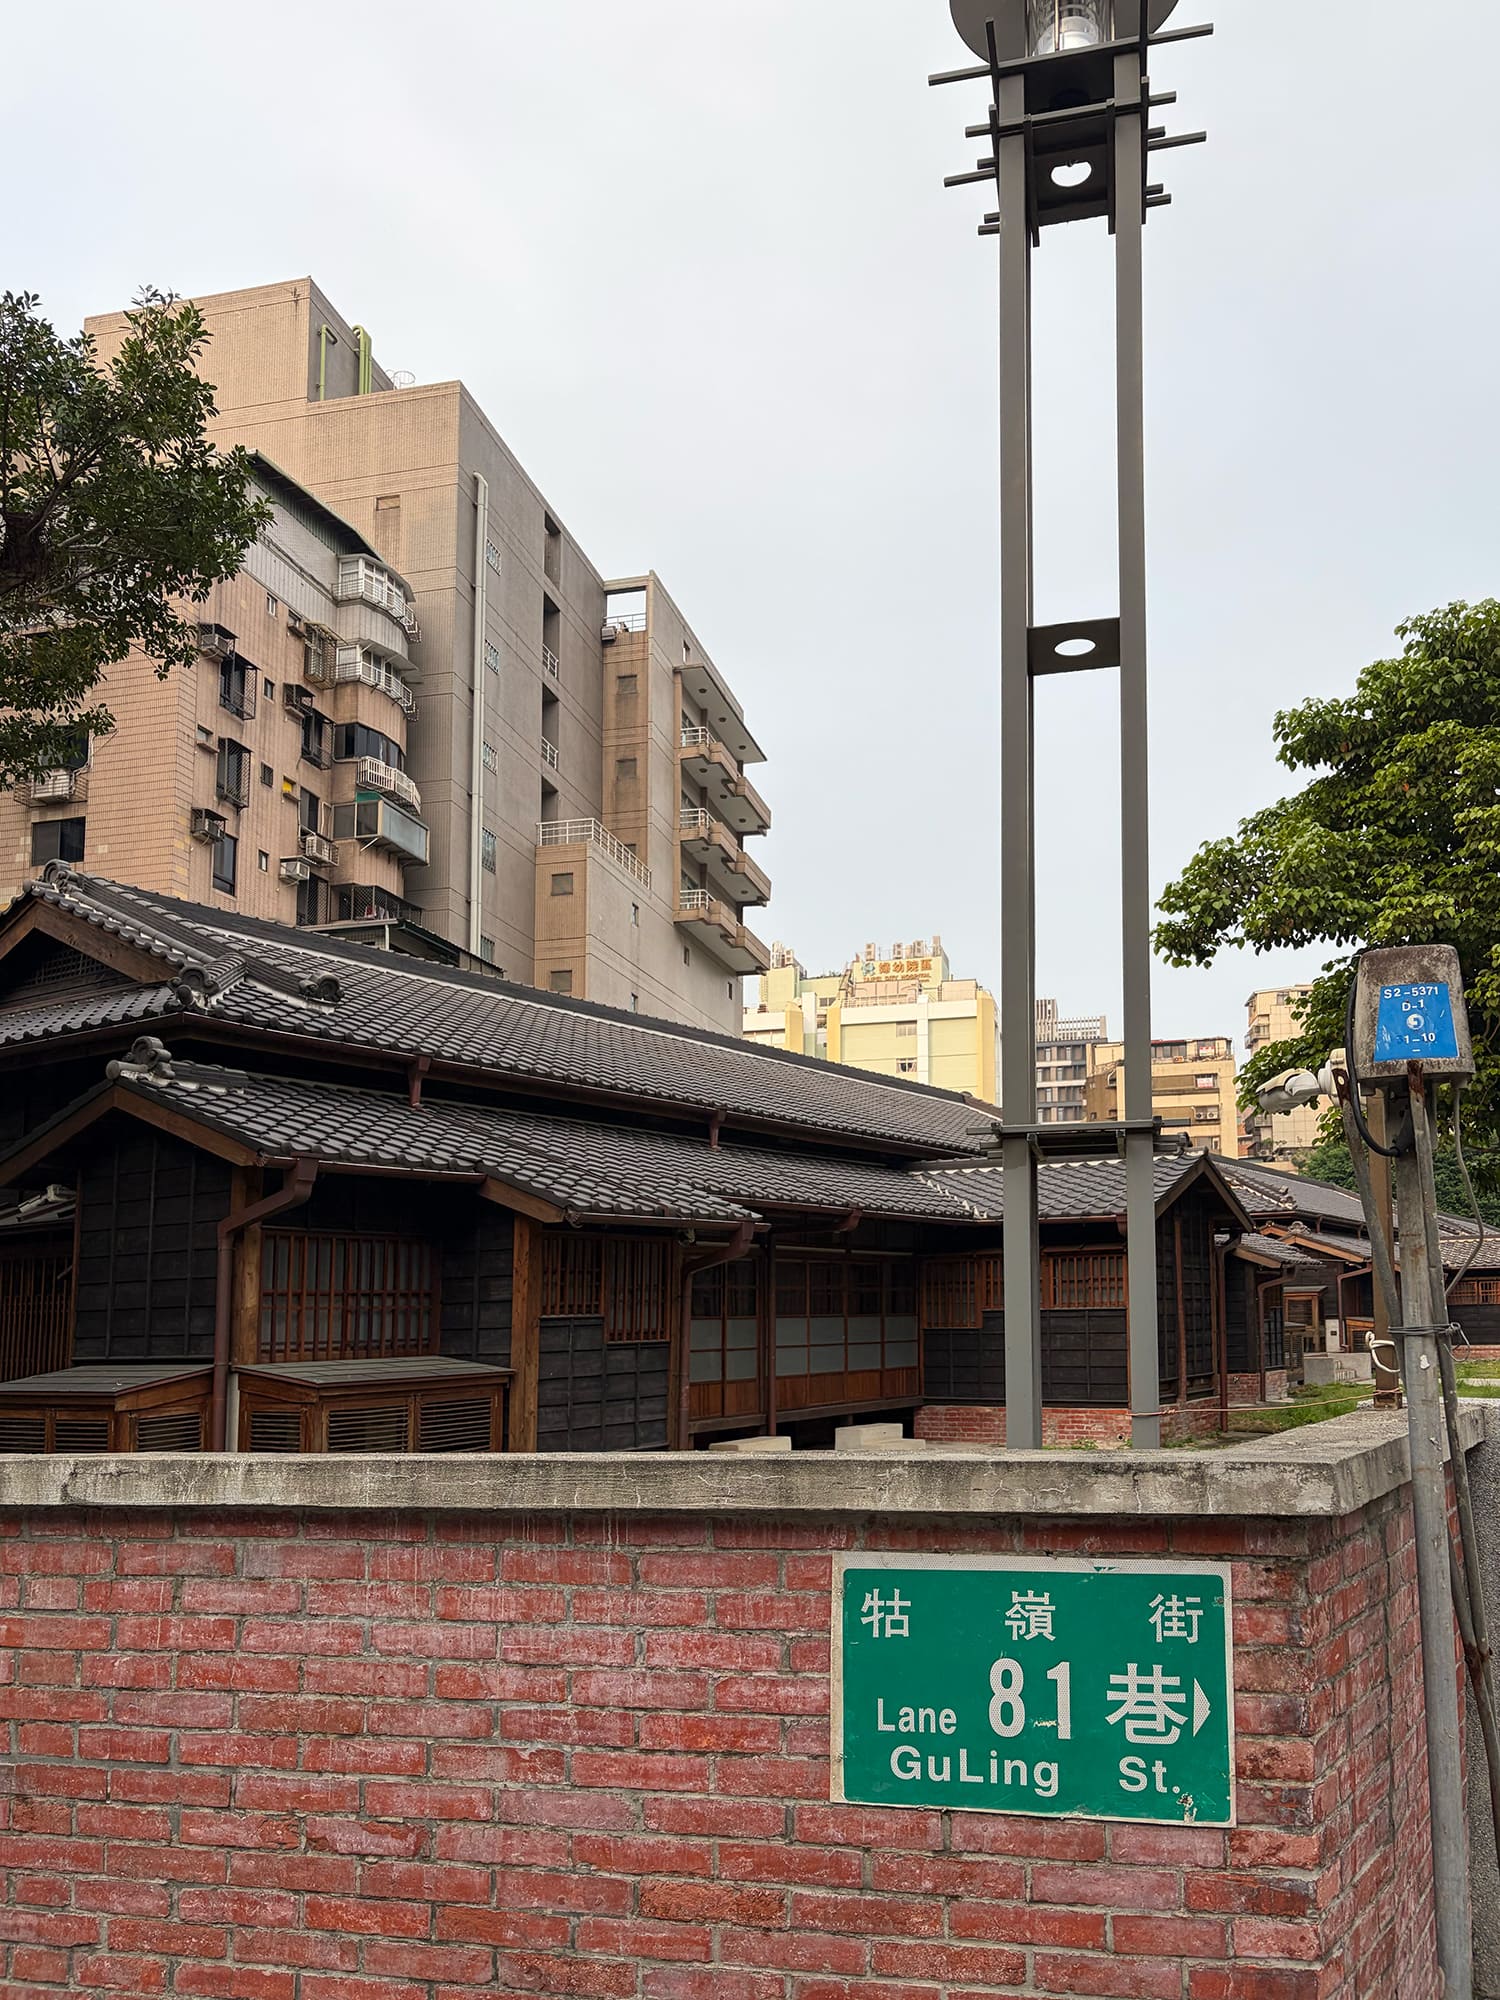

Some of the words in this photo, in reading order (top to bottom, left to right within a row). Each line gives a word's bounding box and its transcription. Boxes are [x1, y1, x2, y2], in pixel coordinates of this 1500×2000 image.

[1384, 986, 1439, 999] S2-5371
[1402, 999, 1424, 1012] D-1
[860, 1588, 1204, 1644] 牯嶺街
[877, 1698, 957, 1735] Lane
[890, 1745, 1059, 1798] GuLing
[1118, 1755, 1181, 1794] St.
